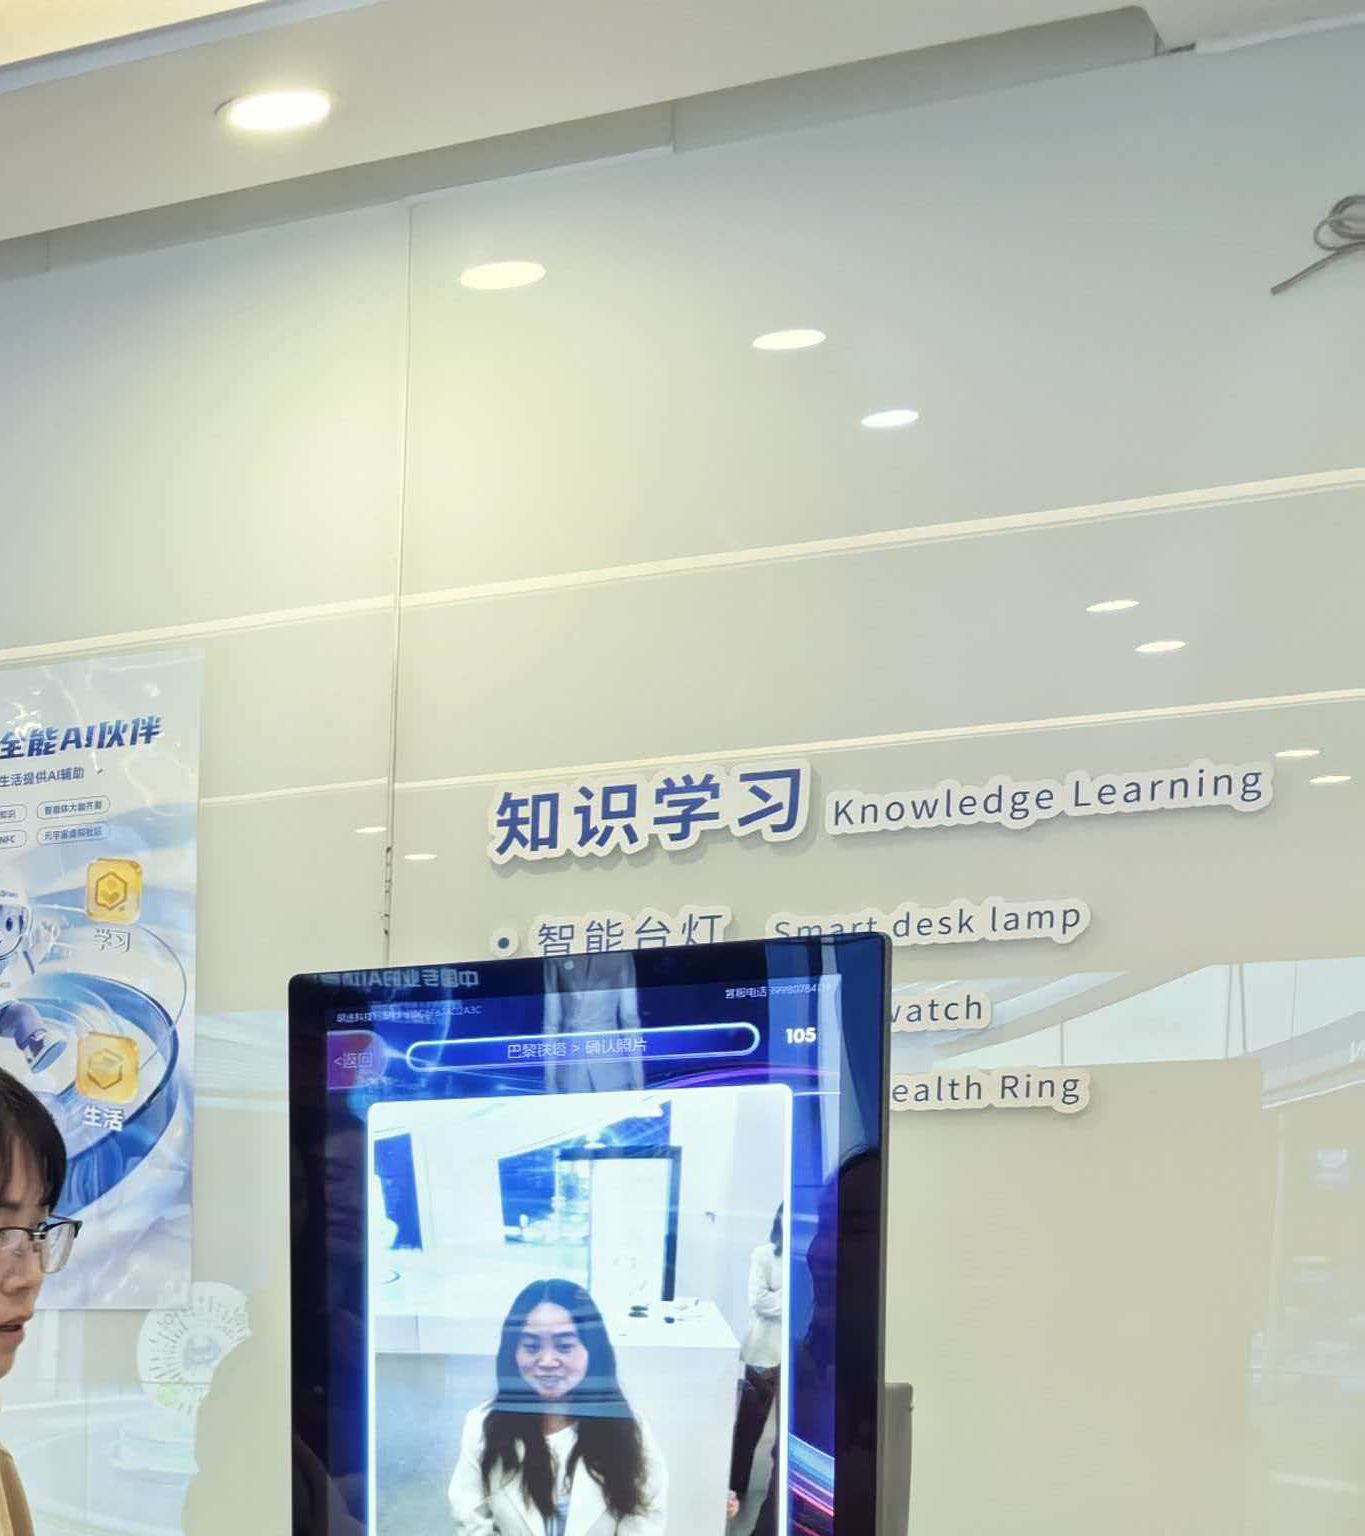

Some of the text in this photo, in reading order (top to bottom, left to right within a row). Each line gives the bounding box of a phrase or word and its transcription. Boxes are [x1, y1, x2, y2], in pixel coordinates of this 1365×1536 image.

[495, 768, 801, 856] 知识学习
[833, 768, 1264, 827] Knowledge Learning
[538, 913, 724, 957] 智能台灯
[892, 908, 976, 938] desk
[990, 906, 1081, 936] lamp
[785, 1027, 818, 1044] 105
[891, 1073, 1080, 1106] ealth Ring
[83, 1105, 125, 1132] 生活
